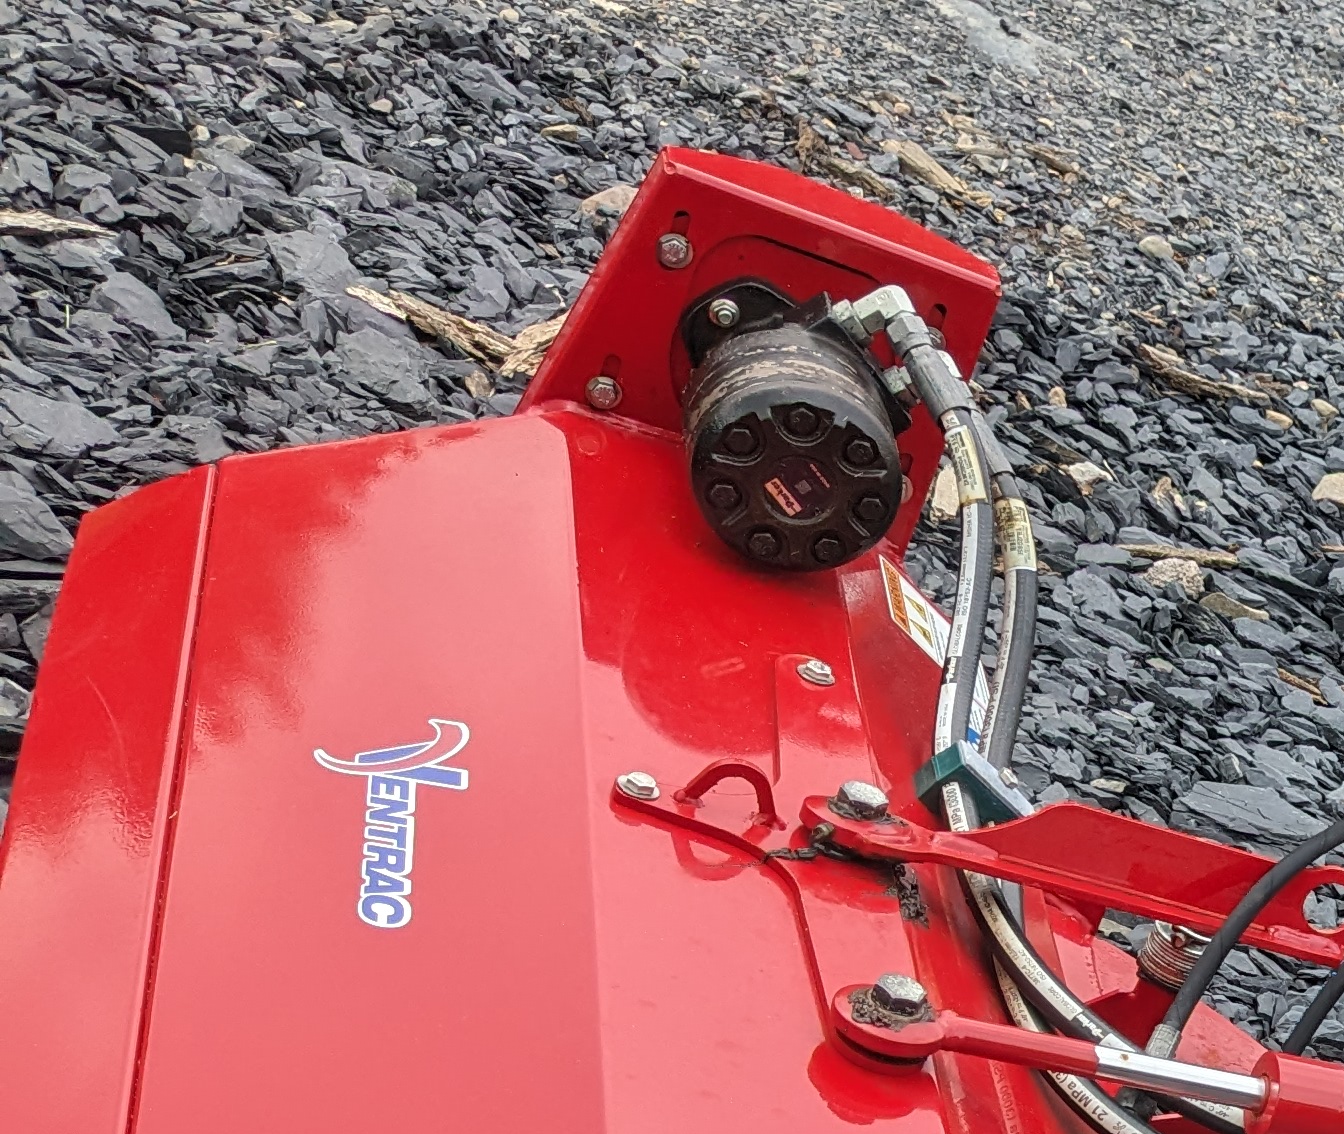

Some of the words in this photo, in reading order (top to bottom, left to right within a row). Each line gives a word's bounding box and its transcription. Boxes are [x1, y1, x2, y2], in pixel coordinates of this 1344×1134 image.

[313, 718, 469, 928] VENTRAC
[1077, 1013, 1105, 1039] Parker
[1067, 1081, 1092, 1108] MPa
[1091, 1107, 1108, 1121] 21
